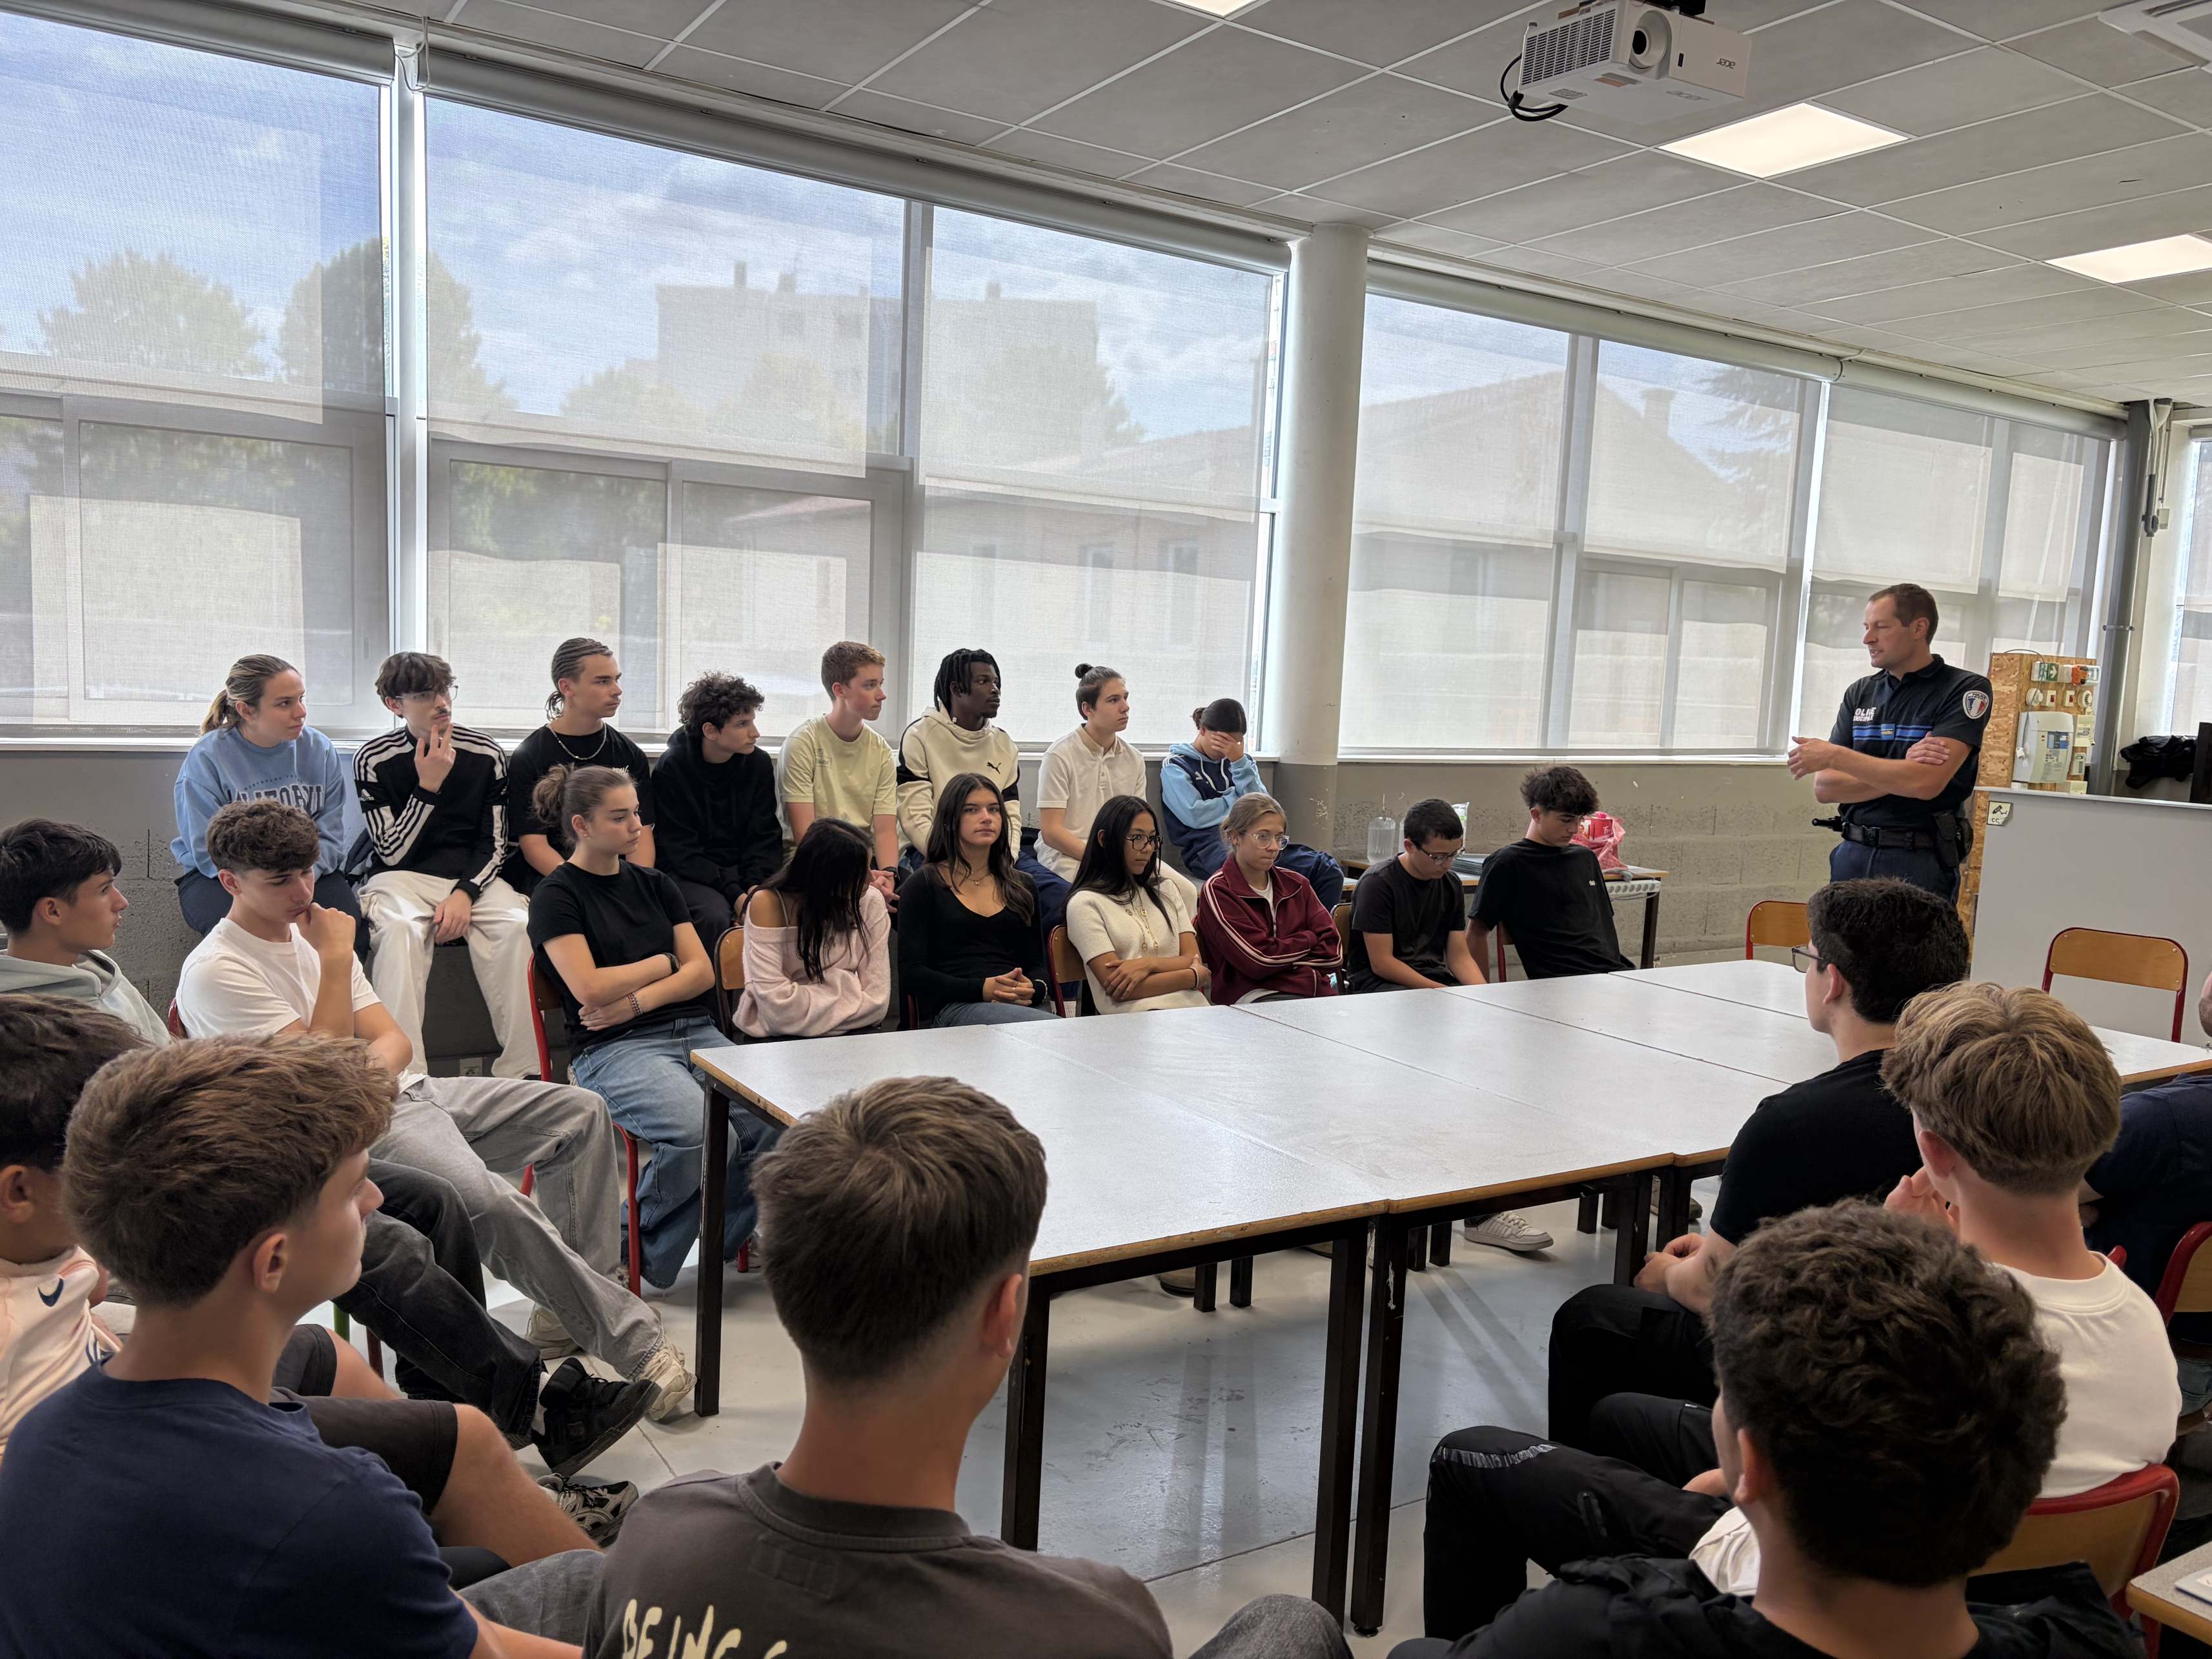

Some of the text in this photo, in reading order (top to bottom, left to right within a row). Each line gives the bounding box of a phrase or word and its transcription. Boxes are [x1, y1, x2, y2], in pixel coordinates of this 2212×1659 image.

[1716, 57, 1736, 69] acer
[1666, 90, 1710, 101] acer
[1854, 707, 1877, 716] OLIE
